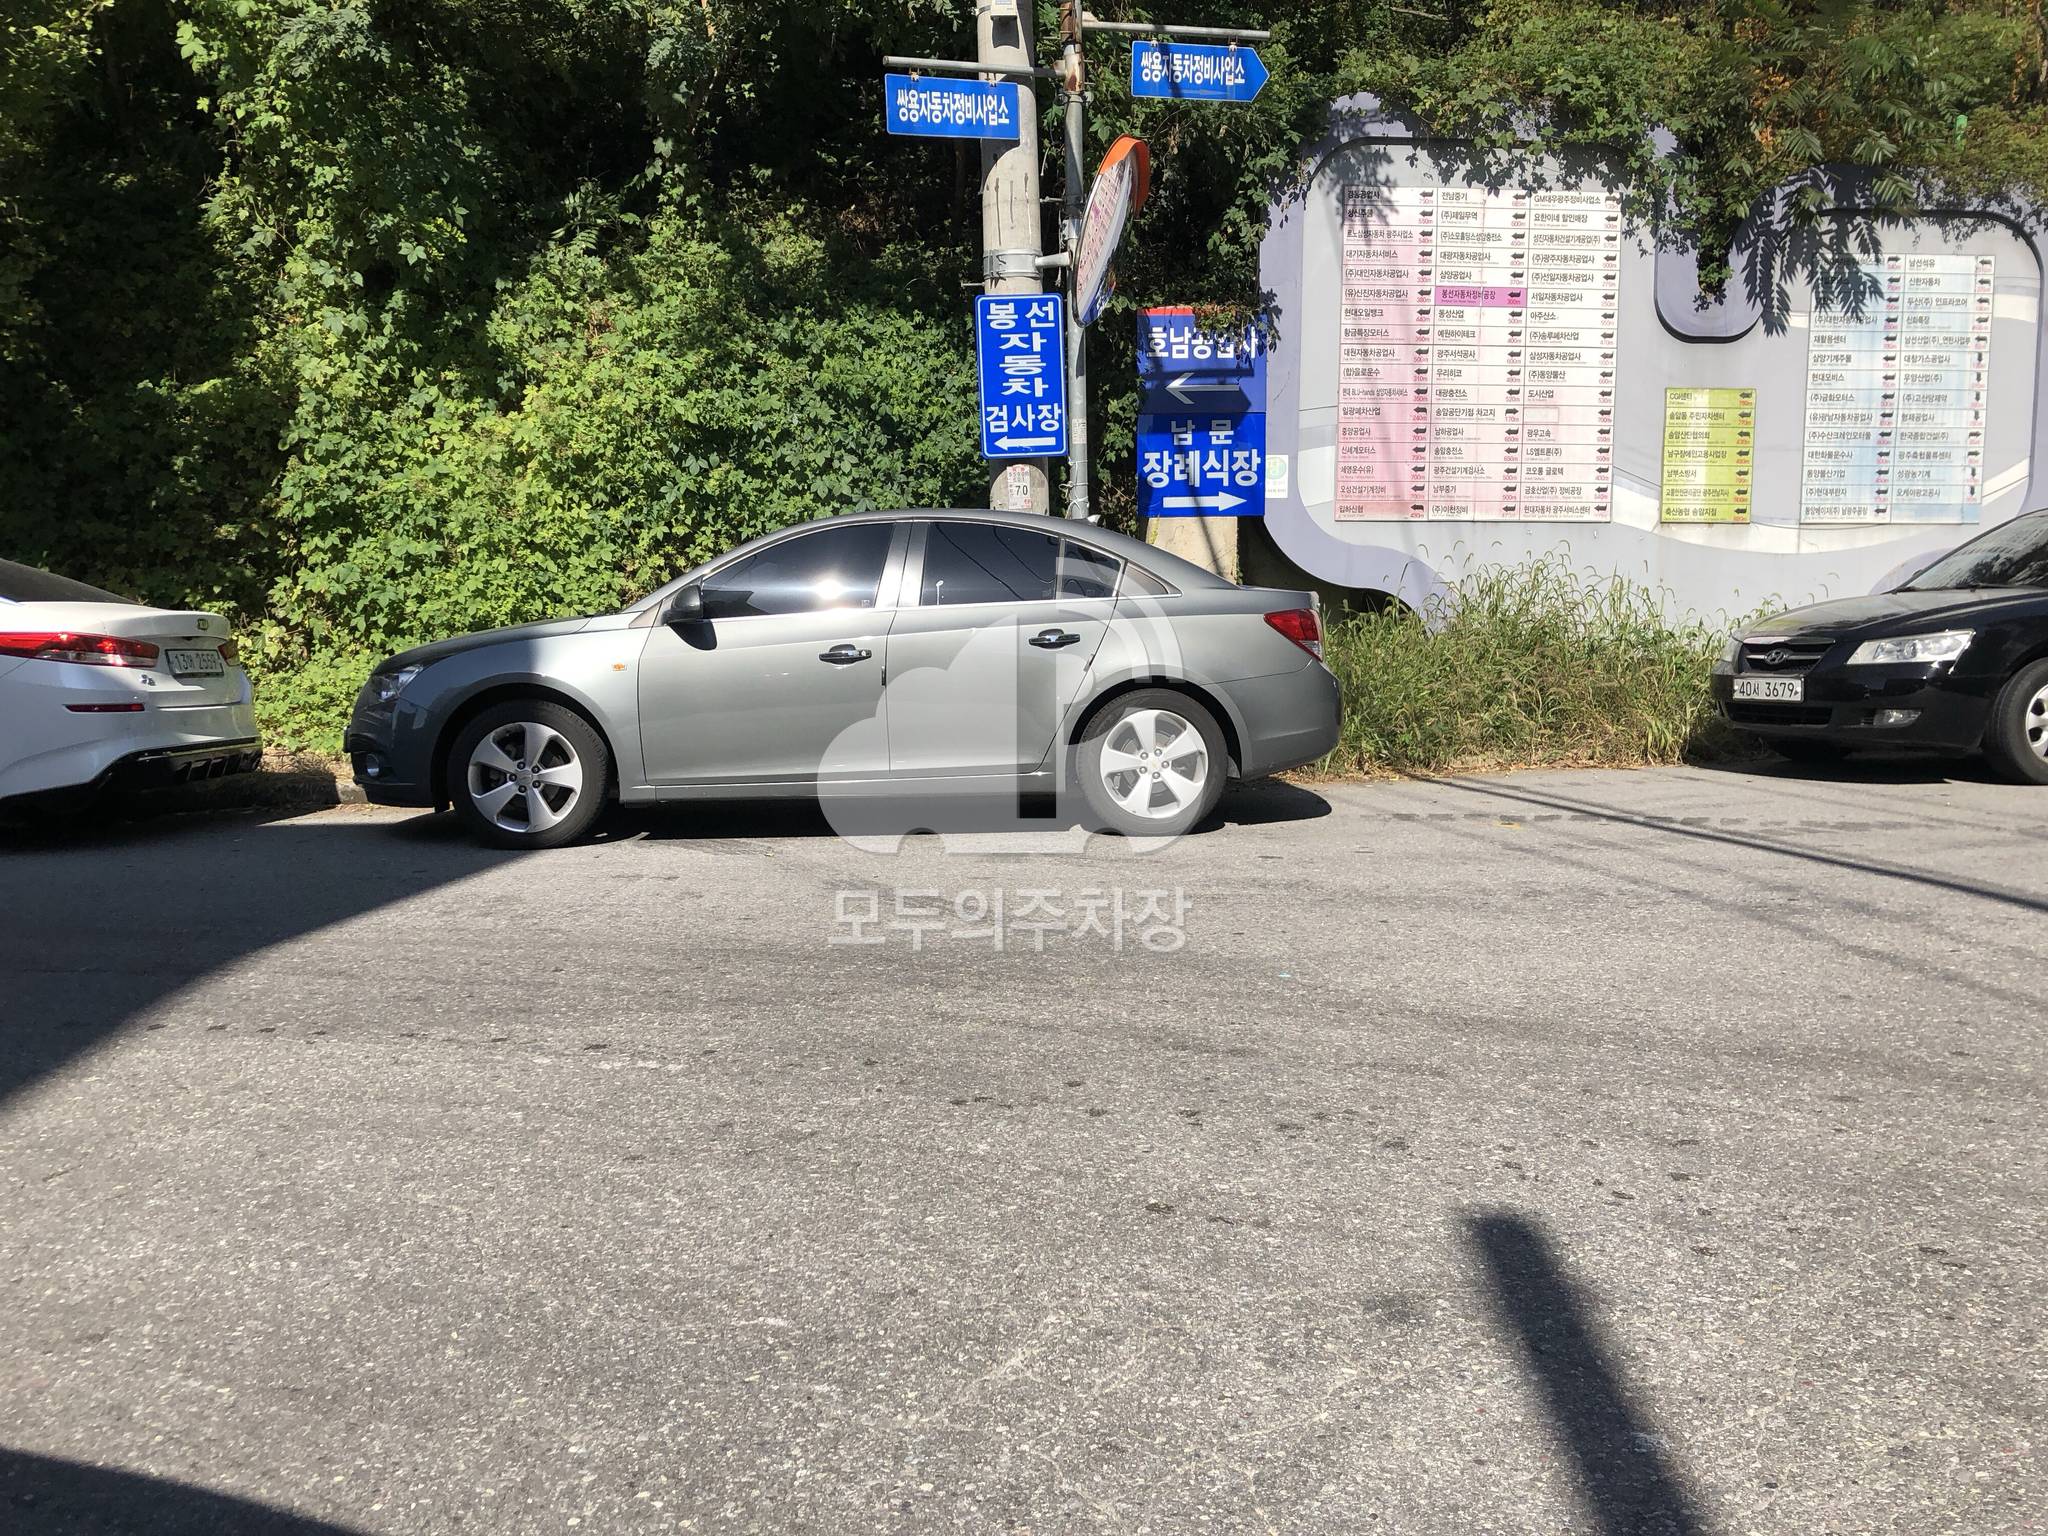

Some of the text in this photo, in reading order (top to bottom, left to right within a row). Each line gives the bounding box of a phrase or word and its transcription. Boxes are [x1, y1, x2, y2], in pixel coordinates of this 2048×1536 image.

[1141, 51, 1246, 86] 쌍용자동차정비사업소
[897, 89, 1010, 126] 쌍용자동차정비사업소
[986, 402, 1062, 433] 검사장
[1143, 448, 1261, 489] 장례식장
[1765, 681, 1795, 698] 3679
